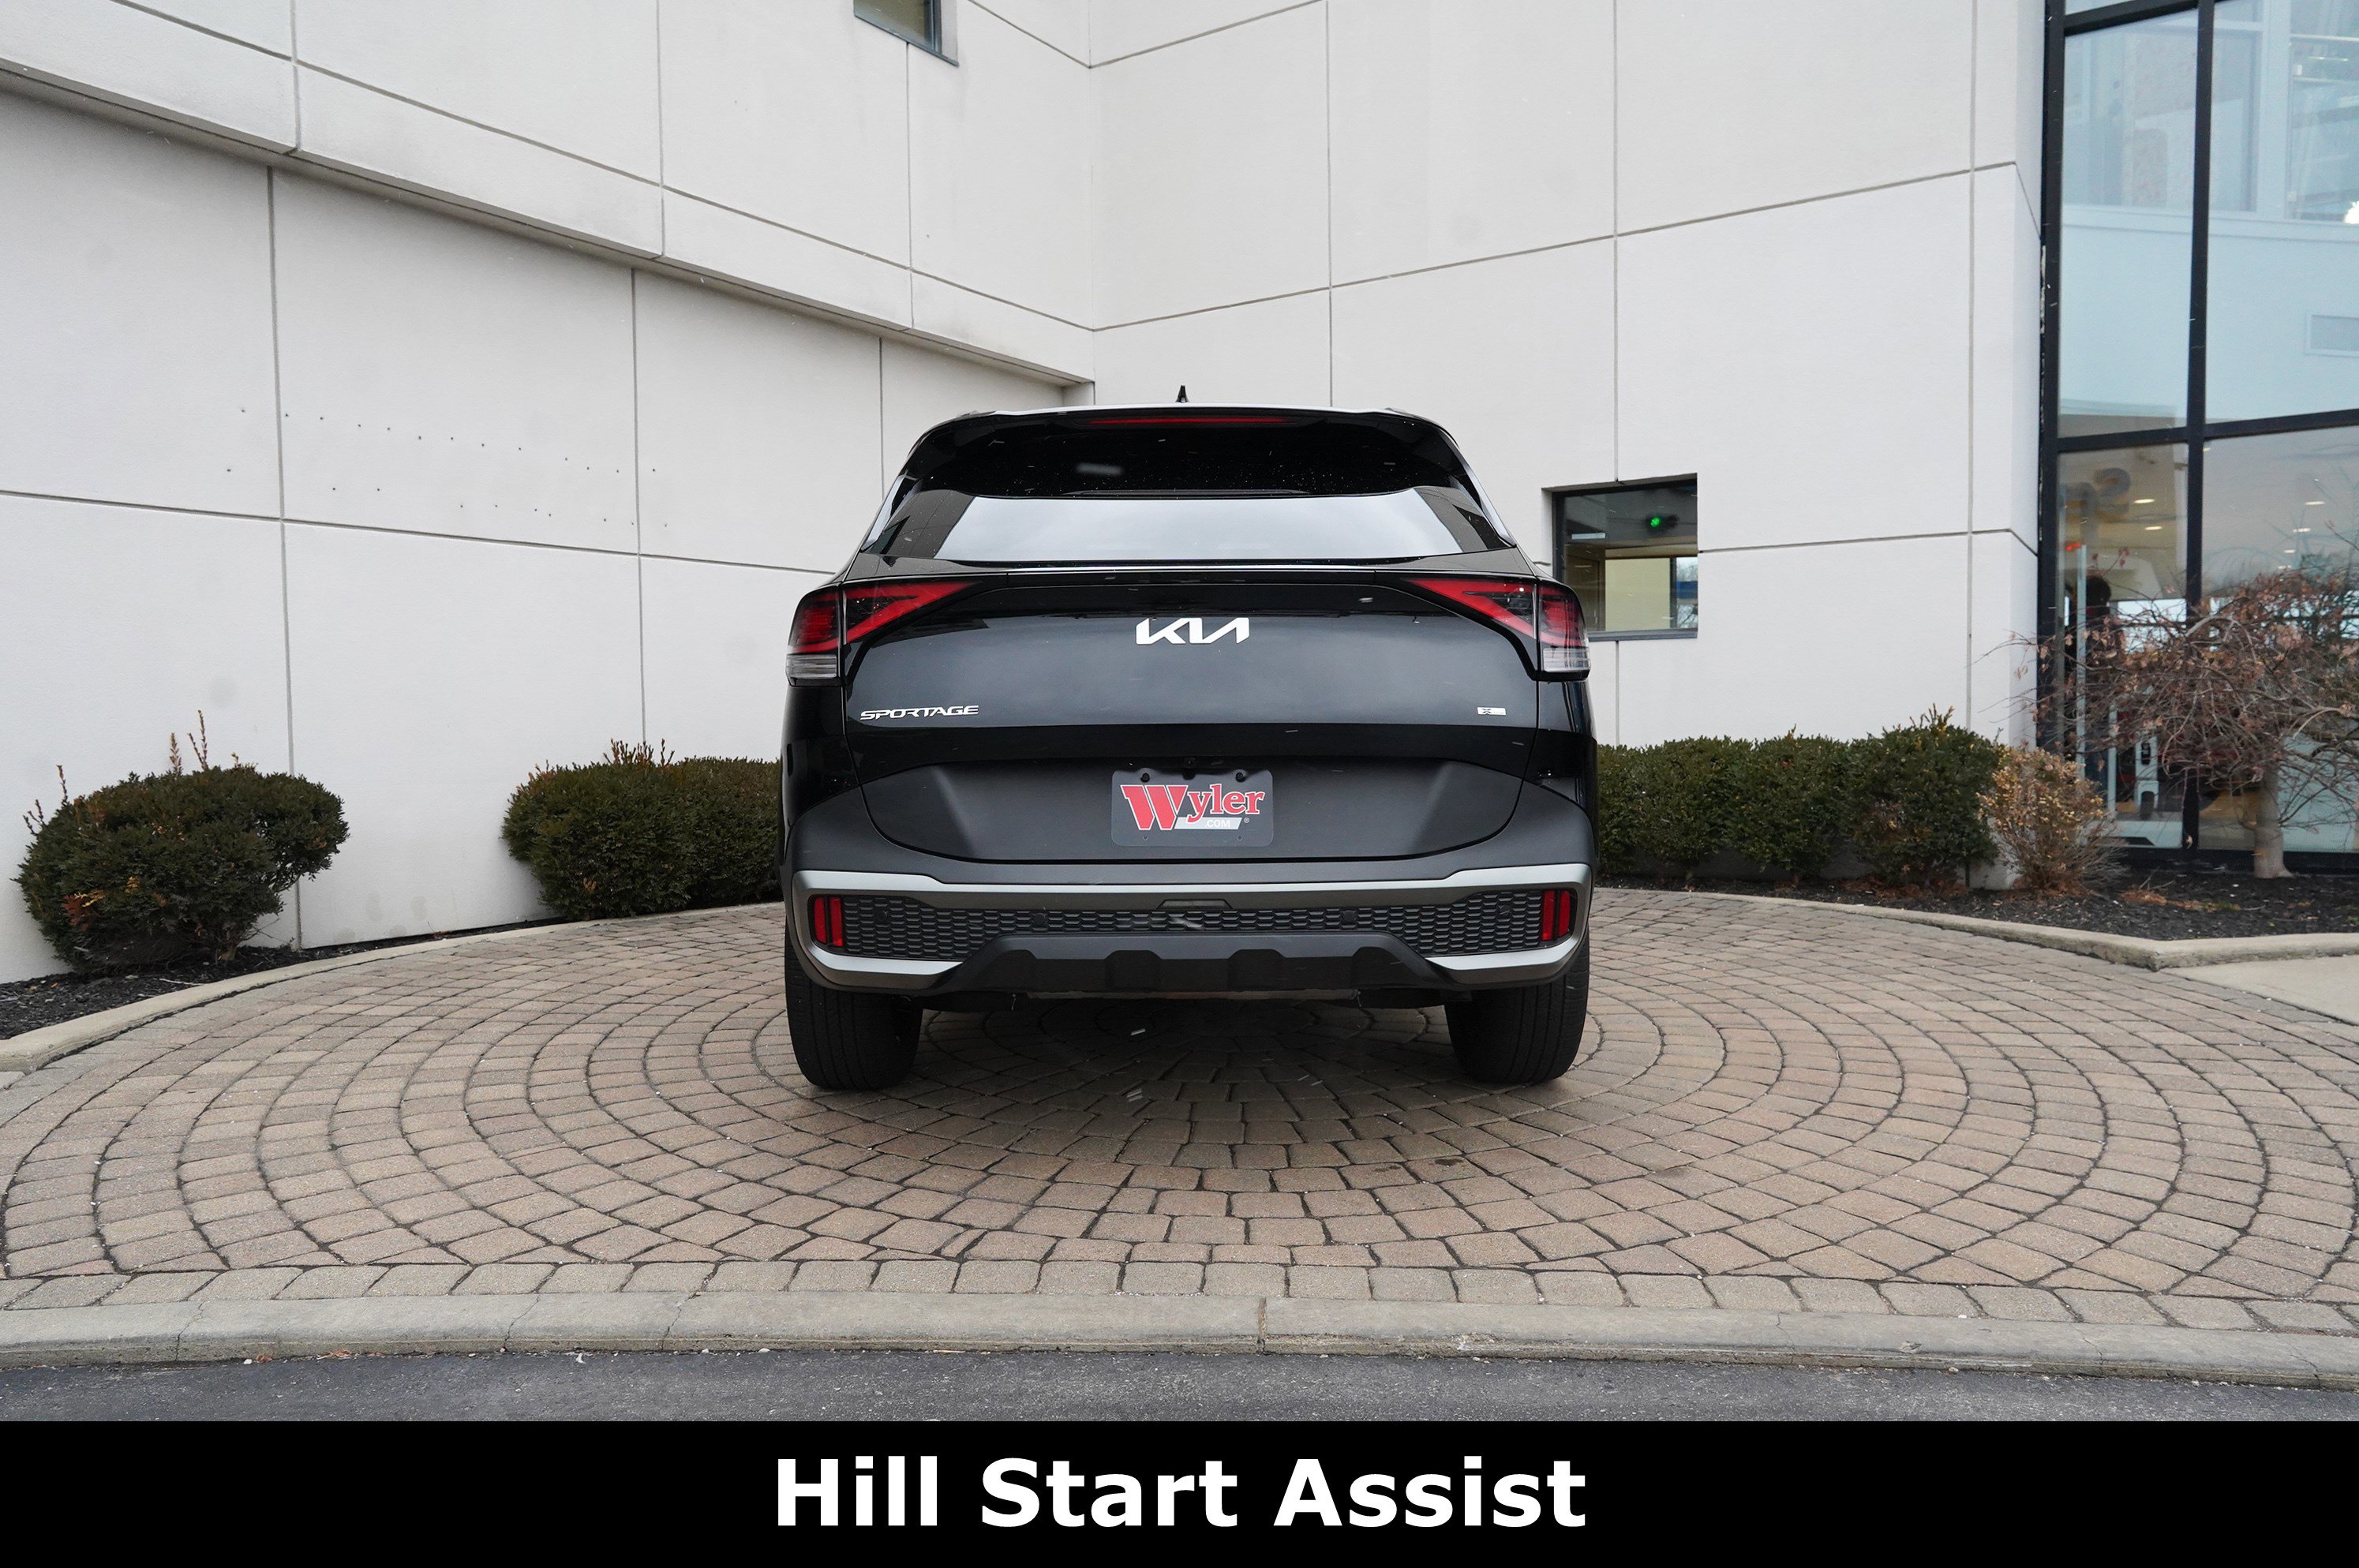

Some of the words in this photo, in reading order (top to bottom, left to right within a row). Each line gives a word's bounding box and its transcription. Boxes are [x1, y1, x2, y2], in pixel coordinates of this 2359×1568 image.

[1136, 617, 1249, 645] KIA
[859, 705, 979, 720] SPORTAGE
[1120, 784, 1265, 830] Wyler
